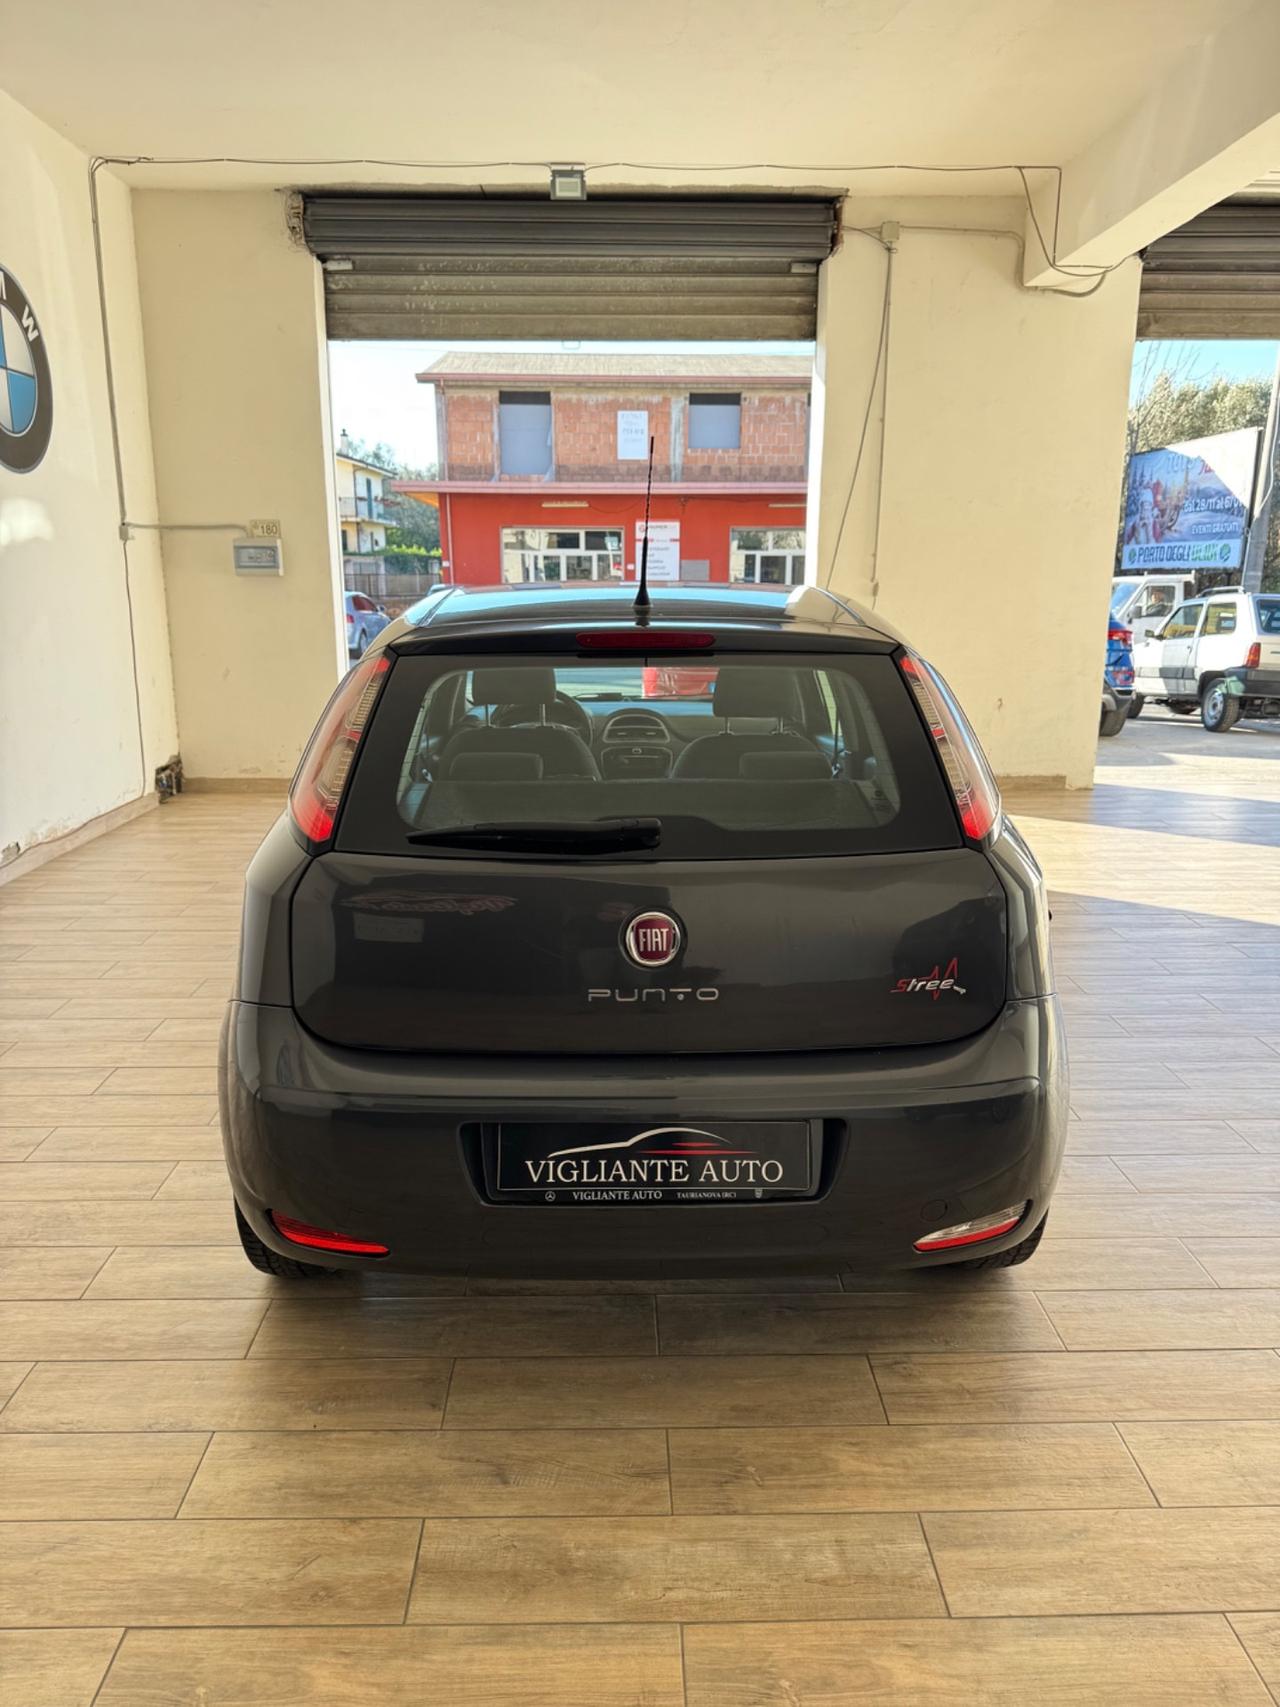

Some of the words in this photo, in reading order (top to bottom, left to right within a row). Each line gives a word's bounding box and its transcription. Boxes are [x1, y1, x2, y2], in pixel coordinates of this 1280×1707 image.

[1138, 544, 1164, 563] PORTO
[1165, 543, 1191, 562] DEGLI
[638, 928, 669, 952] FIAT
[587, 987, 720, 1003] PUNTO
[525, 1159, 690, 1184] VIGLIANTE
[698, 1159, 784, 1183] AUTO
[572, 1190, 630, 1201] VIGLIANTE
[632, 1190, 663, 1200] AUTO
